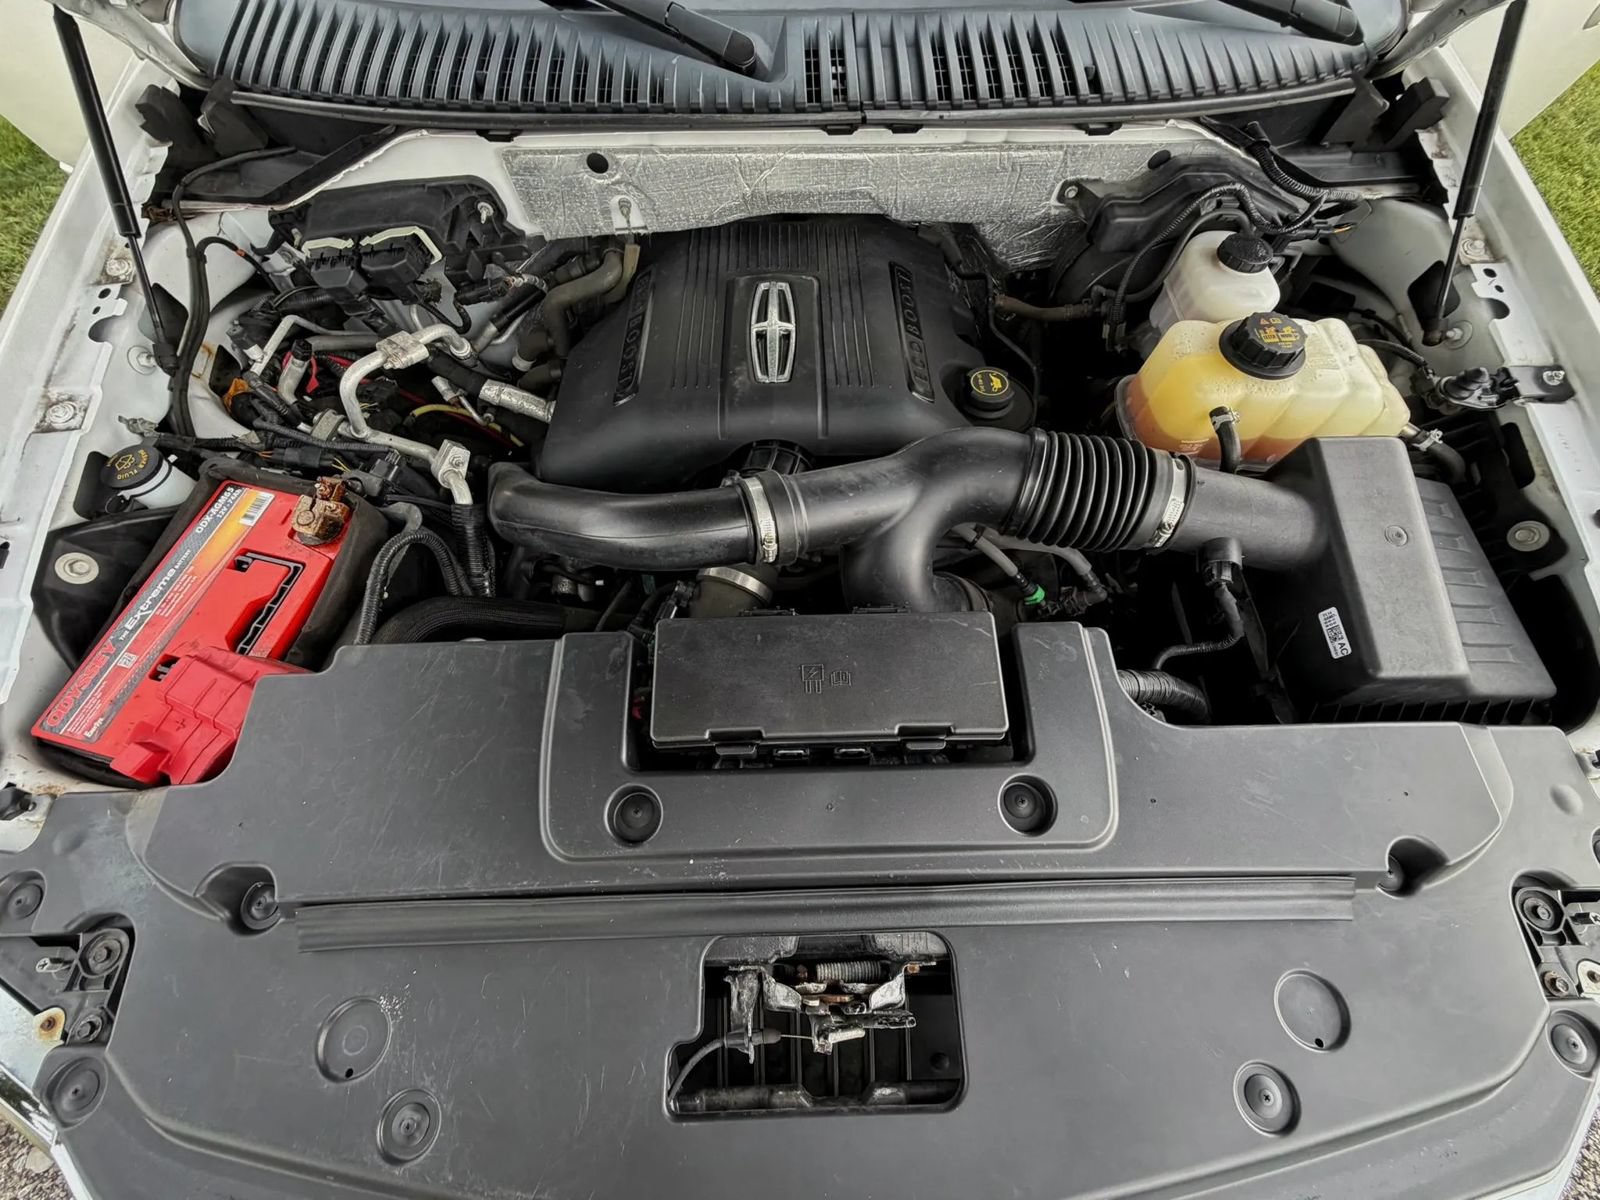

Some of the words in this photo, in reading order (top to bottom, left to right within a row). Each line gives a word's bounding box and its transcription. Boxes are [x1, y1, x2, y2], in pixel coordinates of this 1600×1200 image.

[897, 266, 929, 383] ECOBOOST
[116, 469, 138, 480] FLUID
[194, 486, 235, 533] ODX-AGM65
[215, 507, 228, 518] 12V
[45, 641, 117, 727] ODYSSEY
[118, 630, 130, 640] THE
[124, 567, 178, 630] Extreme
[173, 548, 193, 568] BATTERY
[1337, 642, 1349, 656] AC
